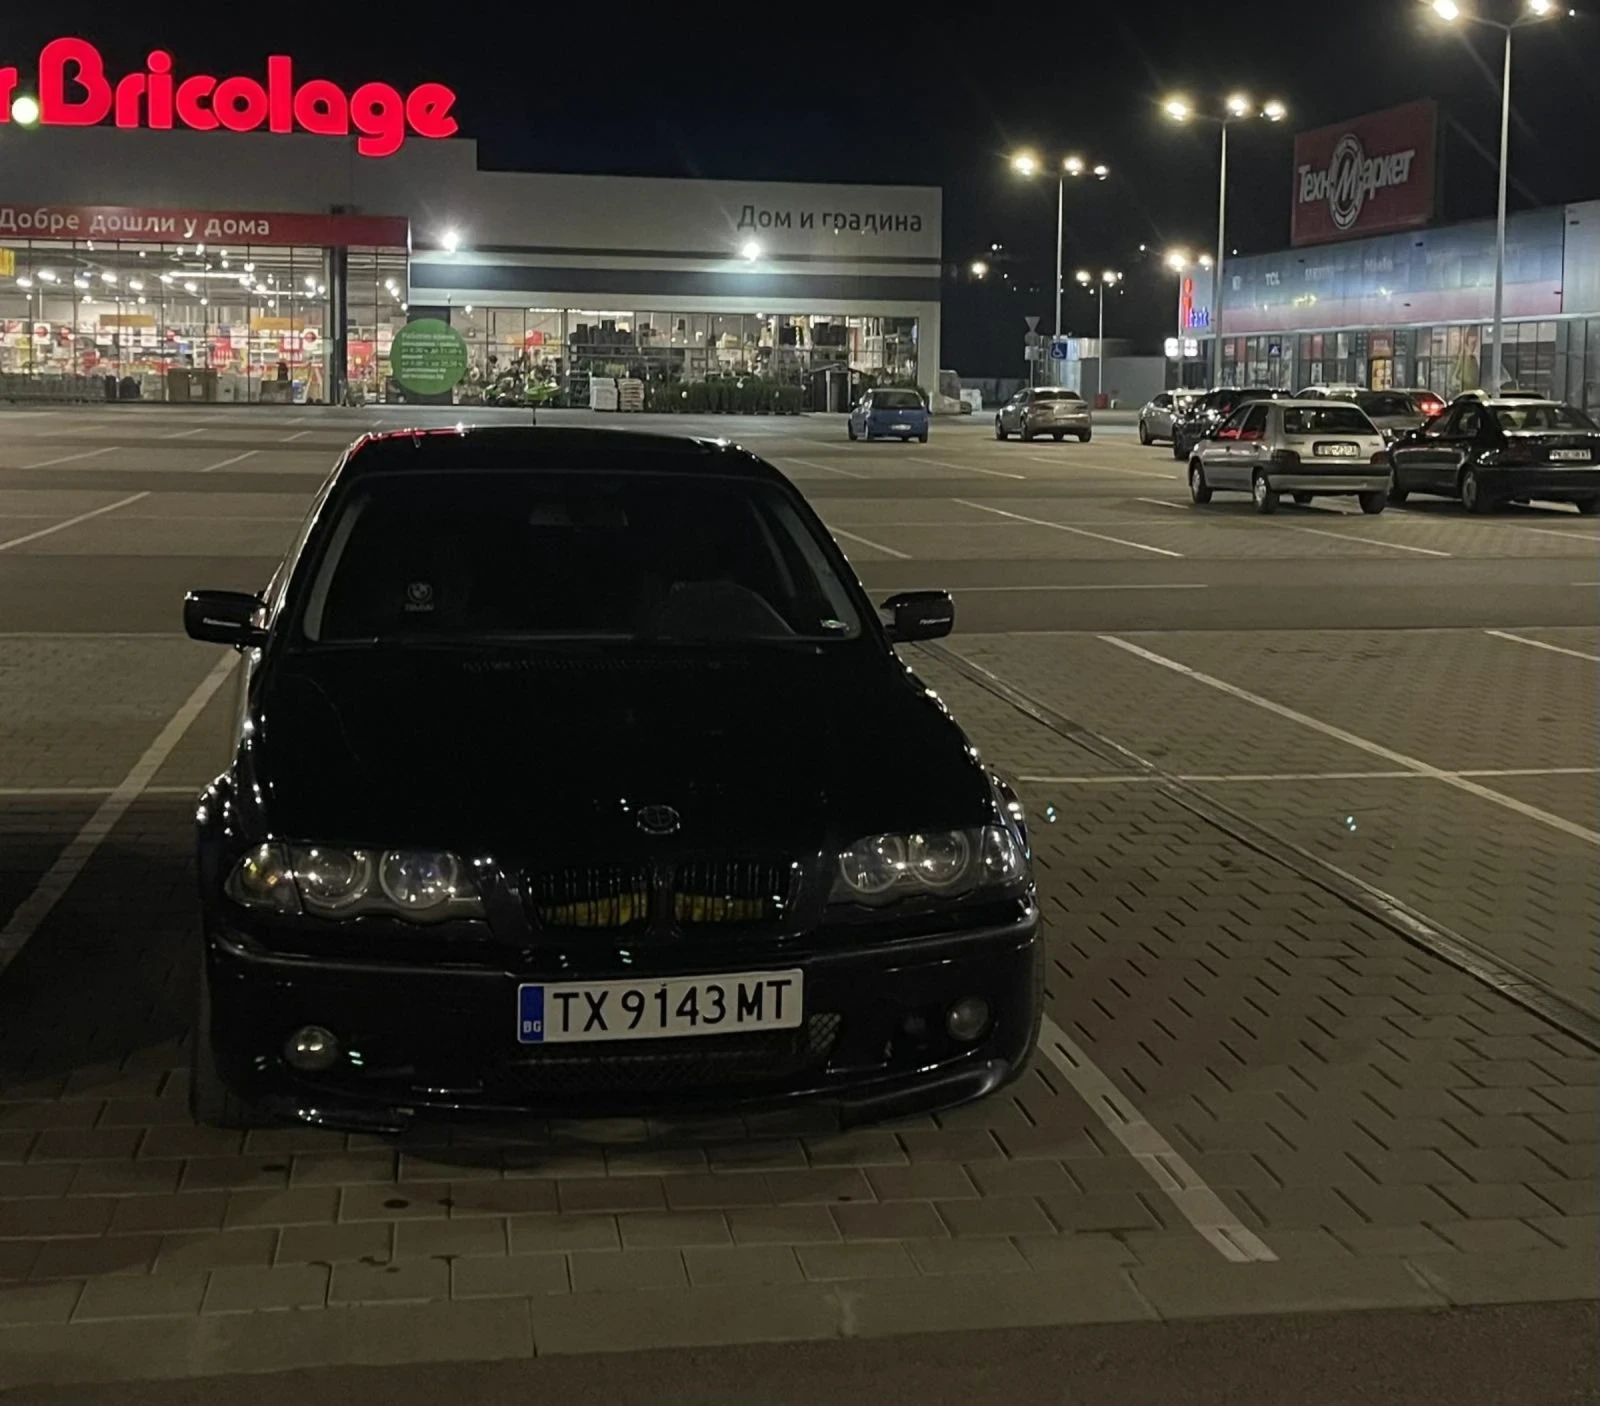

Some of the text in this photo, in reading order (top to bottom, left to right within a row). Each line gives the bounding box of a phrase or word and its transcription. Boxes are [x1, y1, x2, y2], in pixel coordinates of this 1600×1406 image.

[0, 208, 270, 238] Добре дошли у дома
[739, 204, 922, 235] Дом и градина
[621, 985, 726, 1030] 9143
[523, 1021, 541, 1033] BG
